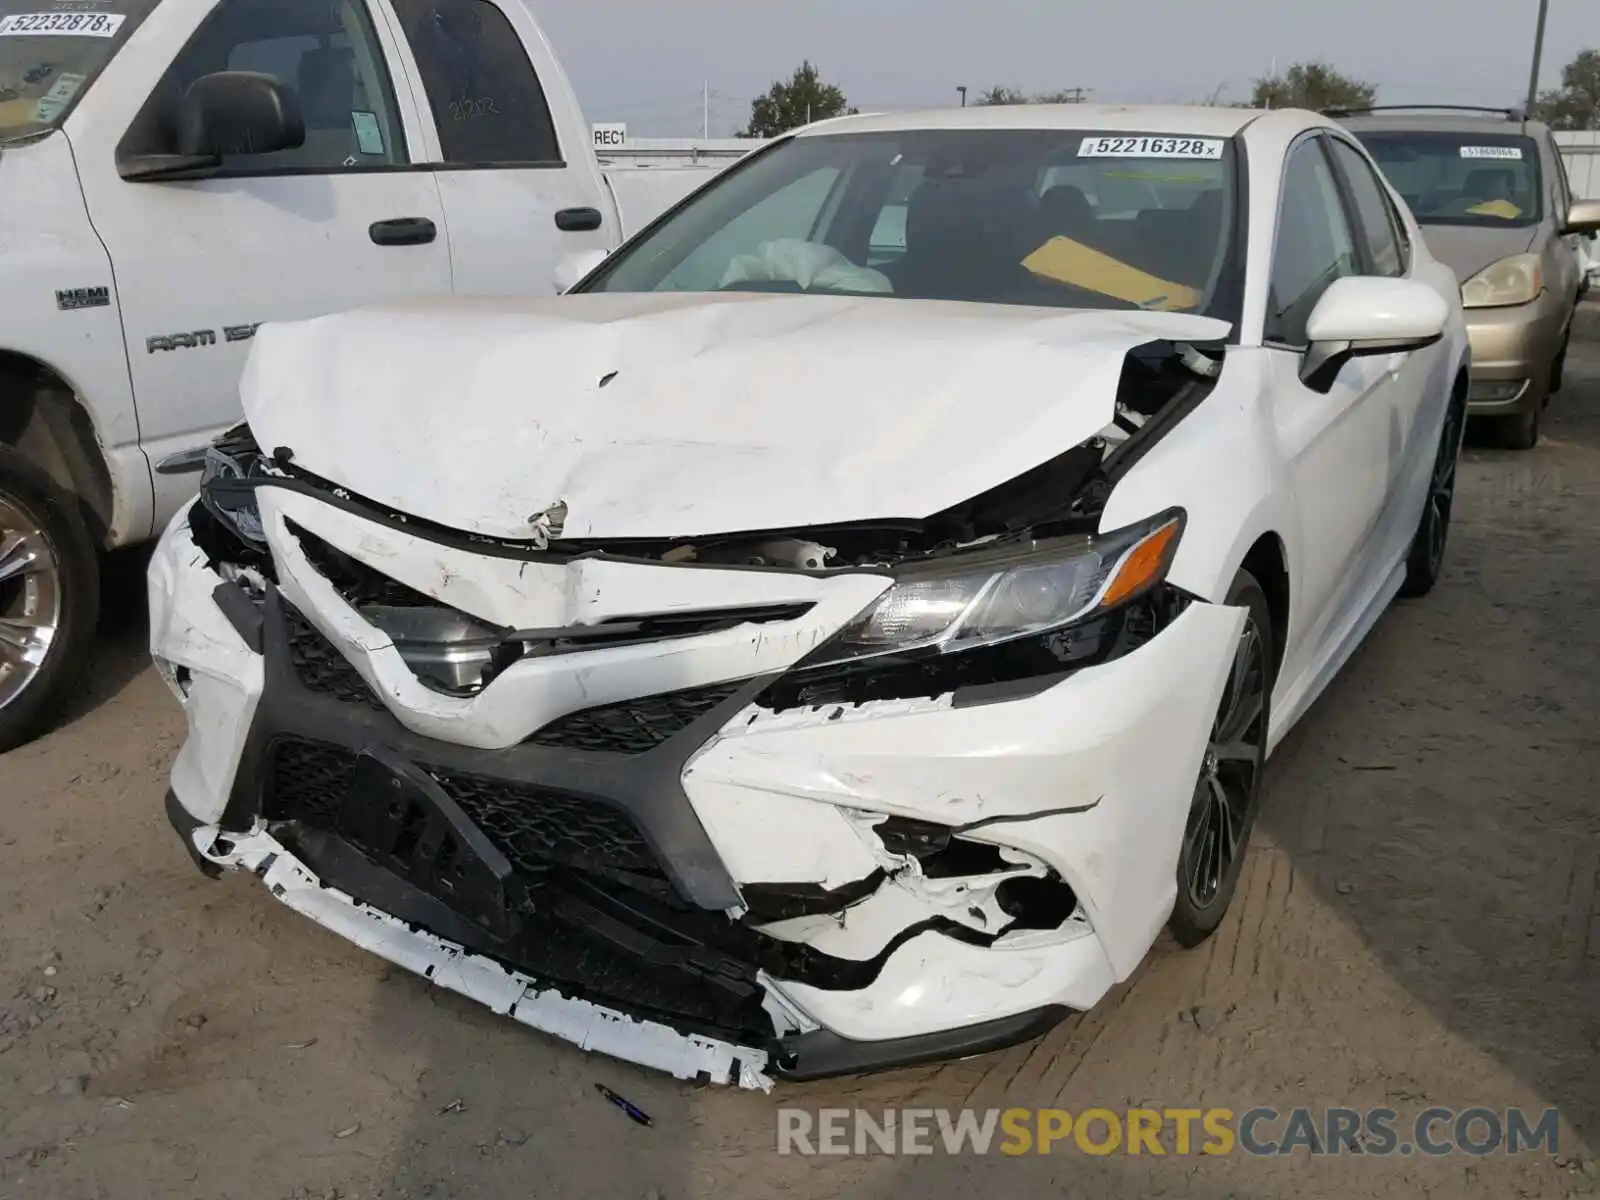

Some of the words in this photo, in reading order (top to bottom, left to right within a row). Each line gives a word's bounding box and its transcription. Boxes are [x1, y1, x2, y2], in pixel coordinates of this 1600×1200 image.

[594, 130, 625, 145] REC1
[55, 287, 109, 301] HEMI
[146, 329, 216, 354] RAM
